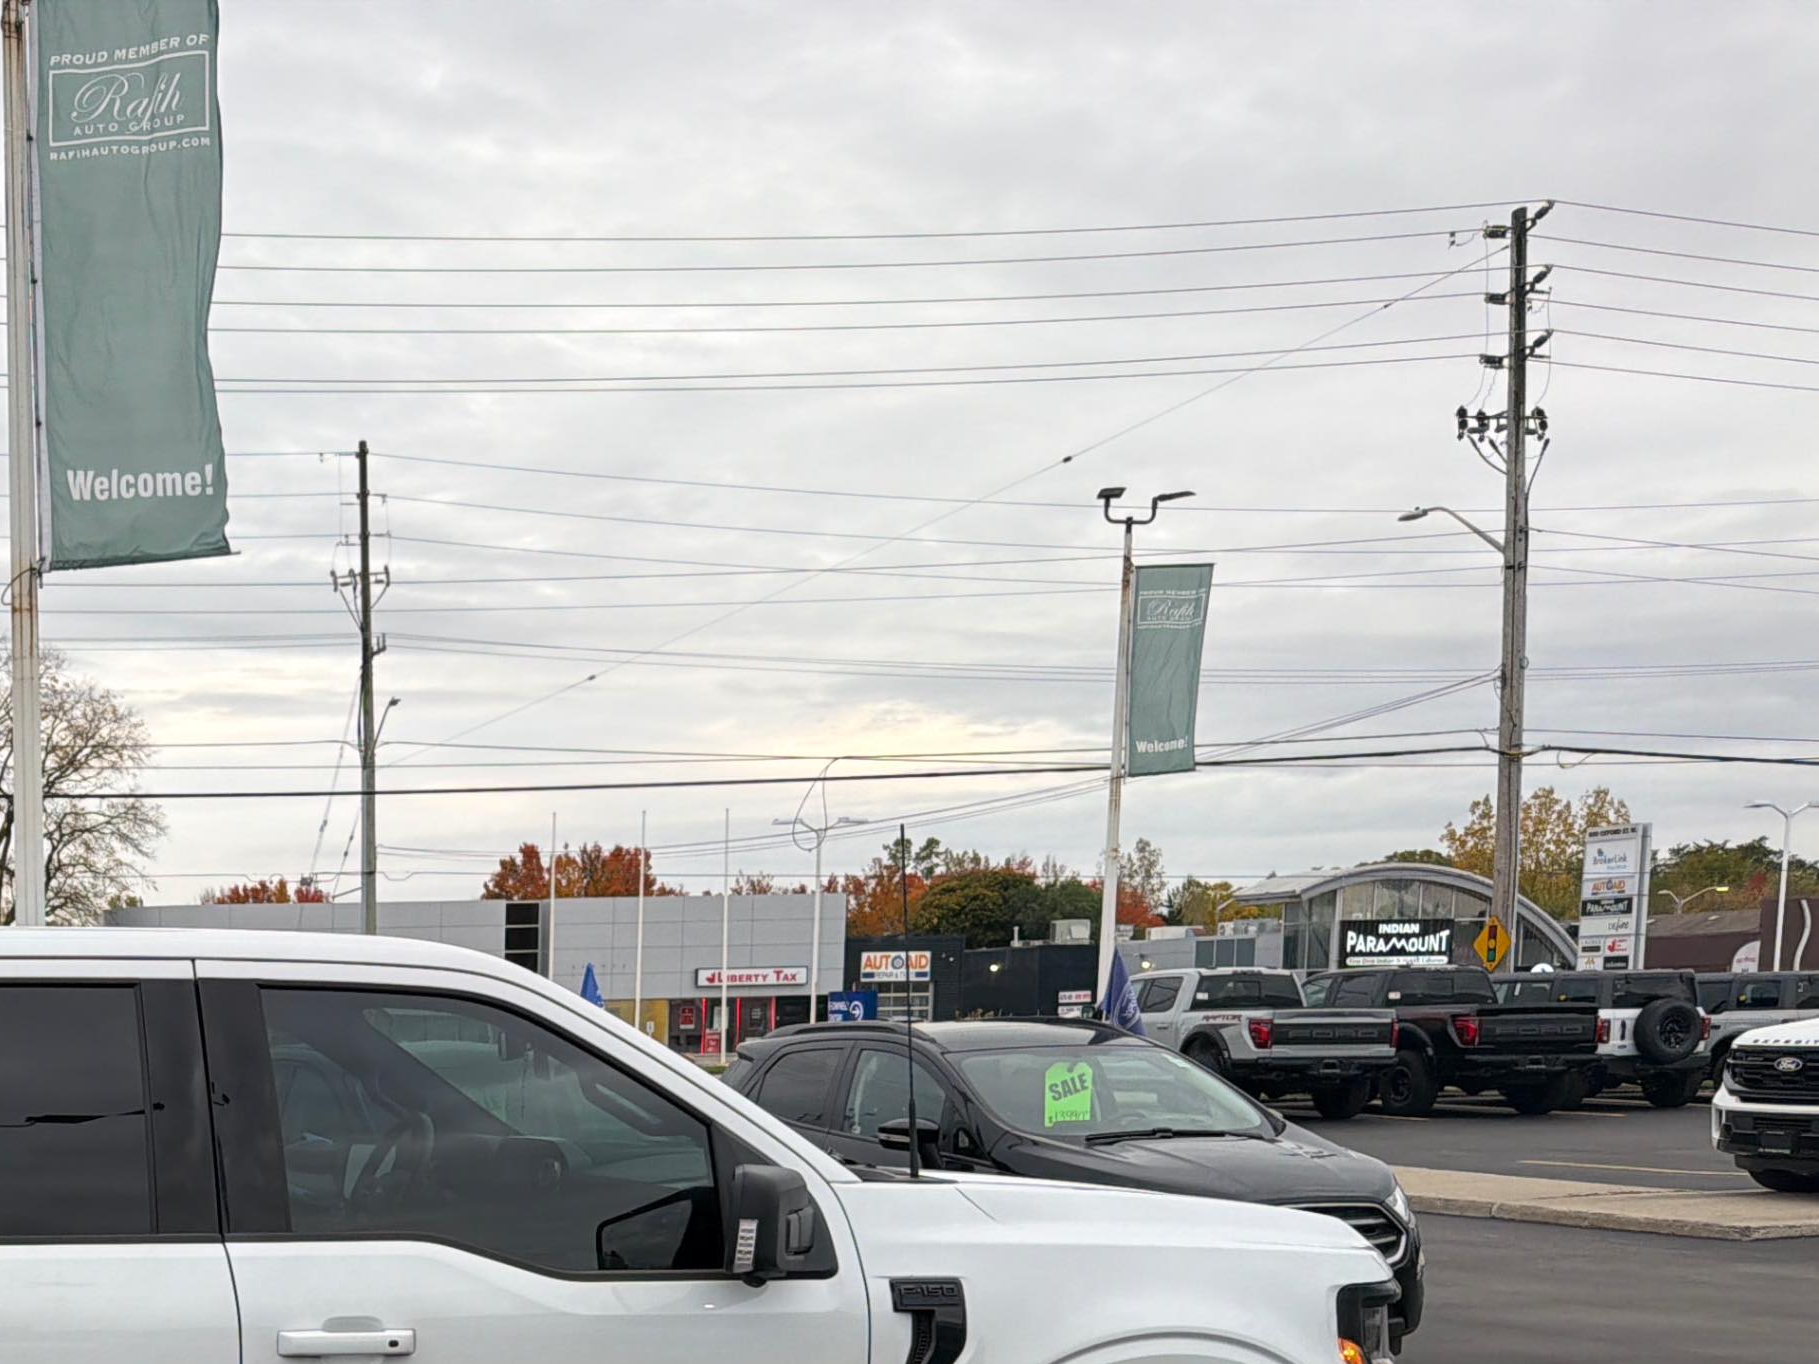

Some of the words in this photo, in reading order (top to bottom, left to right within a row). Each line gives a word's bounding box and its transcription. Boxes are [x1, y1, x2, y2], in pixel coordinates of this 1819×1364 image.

[49, 51, 108, 67] PROUD
[114, 36, 181, 60] MEMBER
[185, 33, 210, 46] OF
[71, 71, 182, 134] Rafih
[73, 122, 119, 137] AUTO
[127, 114, 185, 133] GROUP
[49, 136, 211, 161] RAFIHAUTOGROUP.COM
[66, 463, 214, 501] Welcome!
[1135, 736, 1188, 753] Welcome!
[1346, 928, 1451, 953] PARAMOUNT
[1378, 922, 1421, 935] INDIAN
[717, 970, 769, 983] LIBERTY
[773, 969, 798, 983] TAX
[1048, 1072, 1089, 1101] SALE
